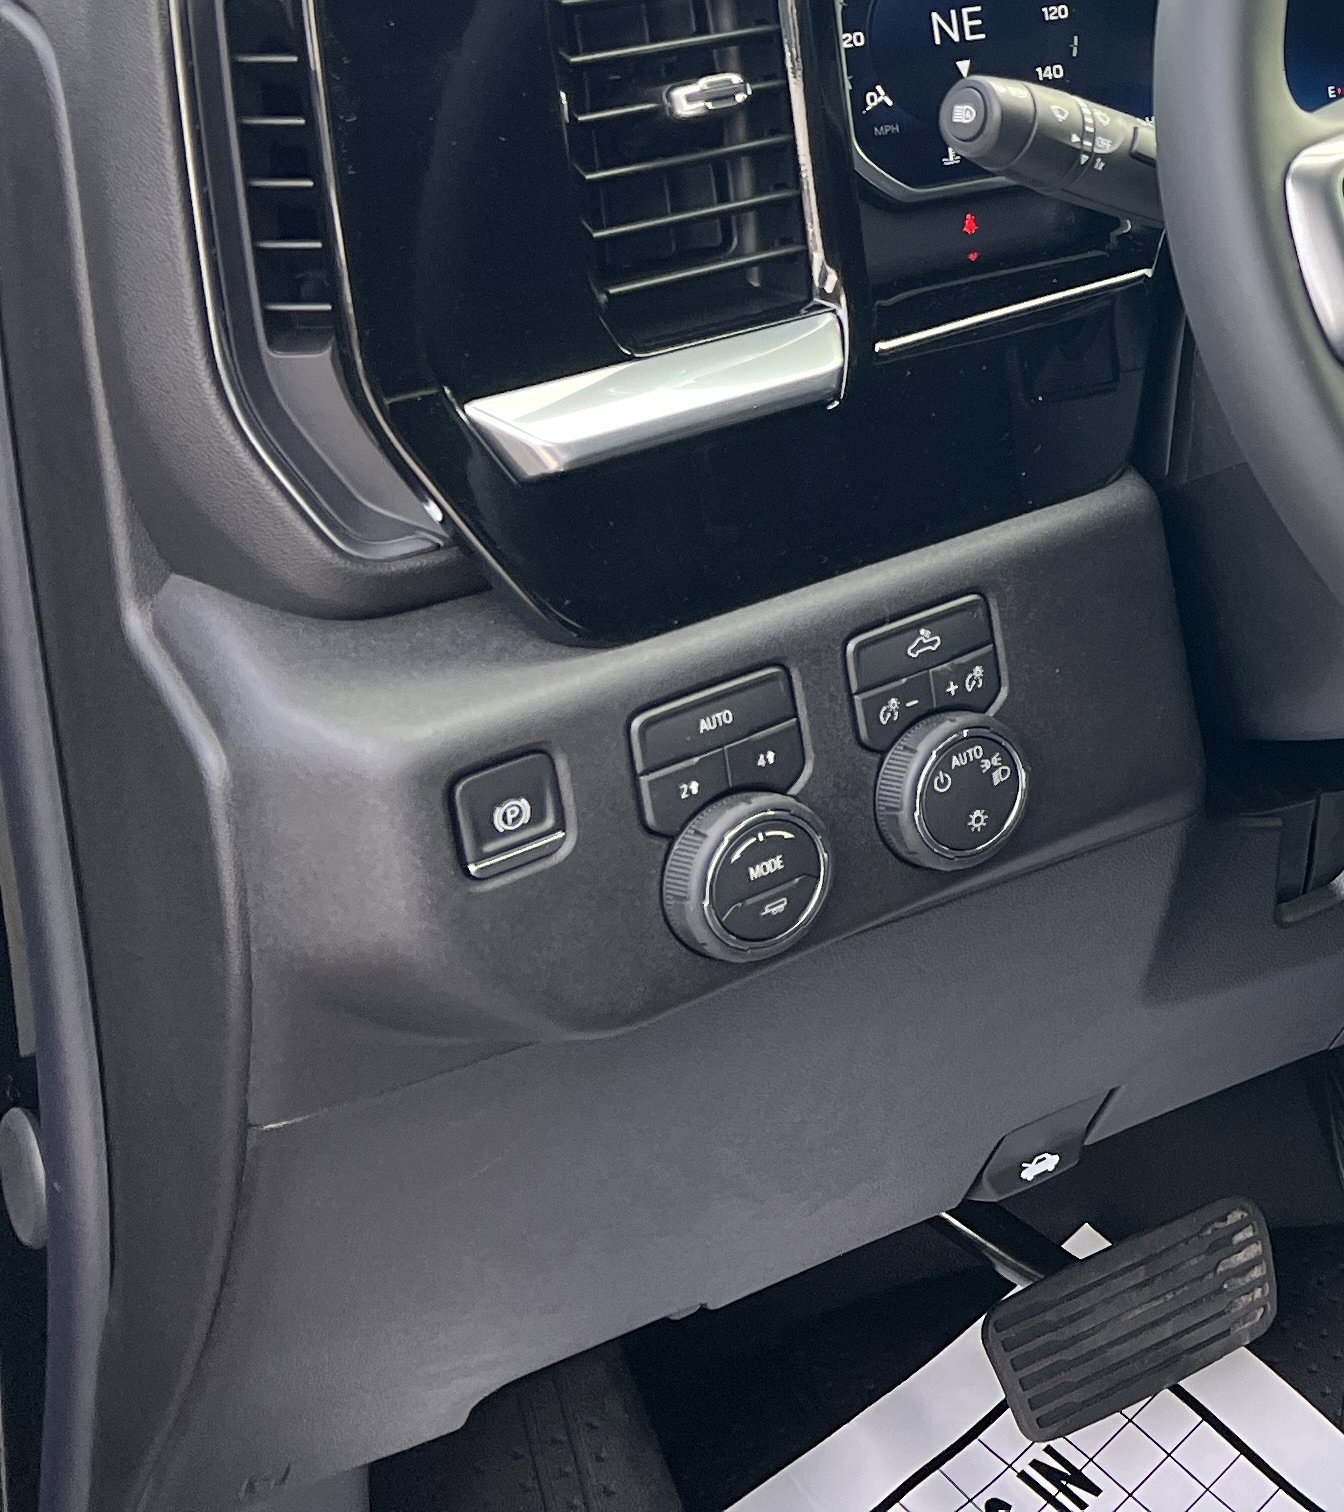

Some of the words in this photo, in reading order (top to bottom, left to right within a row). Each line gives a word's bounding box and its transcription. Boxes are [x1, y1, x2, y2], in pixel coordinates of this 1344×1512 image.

[1041, 4, 1069, 21] 120
[930, 5, 986, 45] NE
[842, 31, 865, 48] 20
[1035, 64, 1065, 81] 140
[1327, 85, 1337, 99] E
[874, 123, 900, 137] MPH
[699, 709, 733, 734] AUTO
[951, 745, 984, 770] AUTO
[748, 854, 785, 881] MODE
[1016, 1443, 1104, 1512] IN
